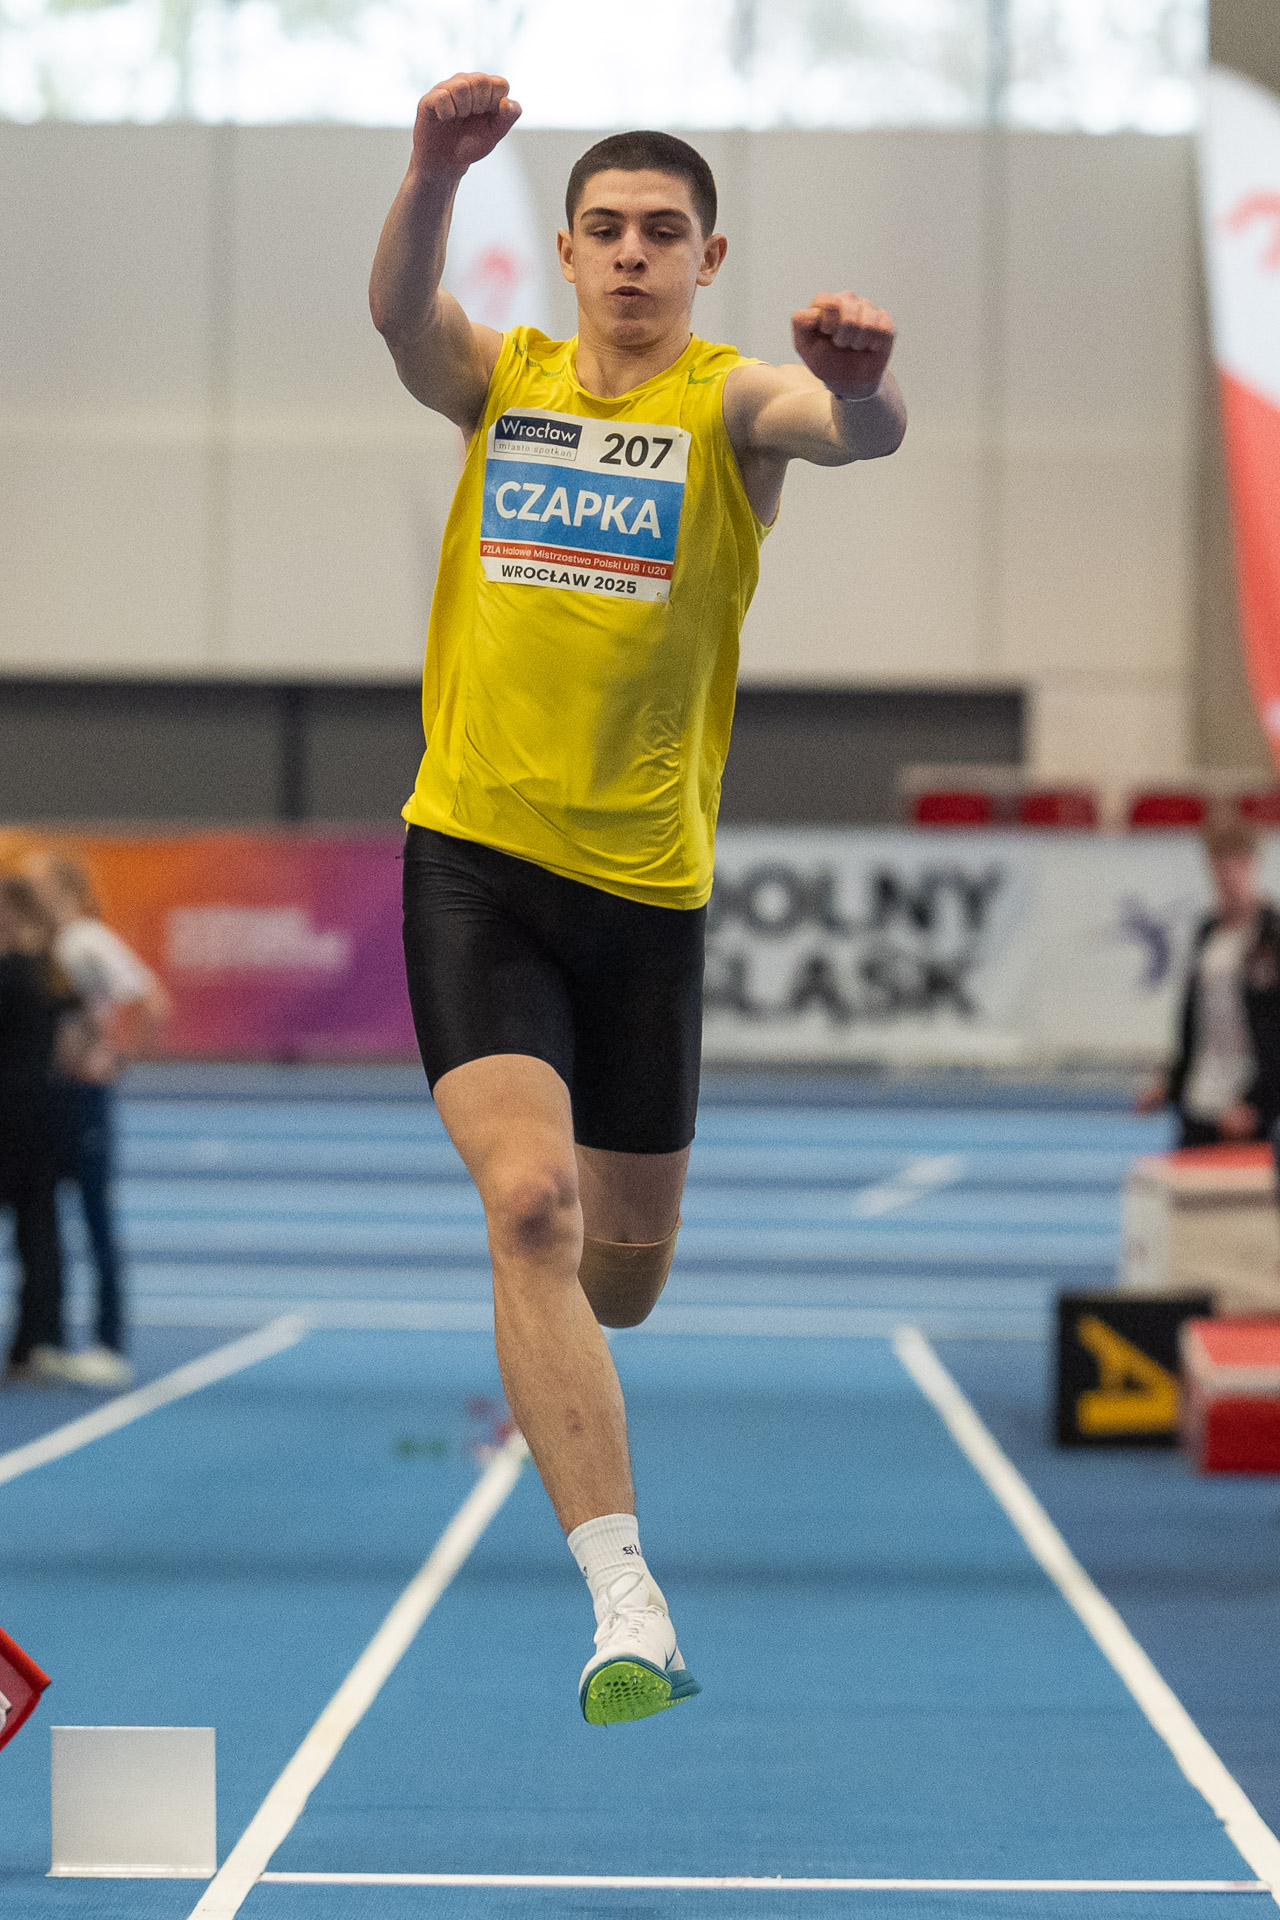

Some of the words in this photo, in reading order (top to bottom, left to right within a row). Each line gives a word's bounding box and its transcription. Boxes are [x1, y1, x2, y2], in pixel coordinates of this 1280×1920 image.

[501, 418, 577, 443] Wrocław
[499, 443, 530, 452] miasto
[533, 447, 572, 458] spotkań
[599, 433, 674, 469] 207
[495, 481, 662, 539] CZAPKA
[482, 544, 501, 554] PZLA
[502, 546, 532, 557] Halowe
[533, 549, 592, 565] Mistrzostwa
[593, 557, 622, 570] Polski
[623, 562, 640, 572] U18
[647, 565, 667, 576] U20
[501, 564, 591, 587] WROCŁAW
[593, 576, 637, 594] 2025
